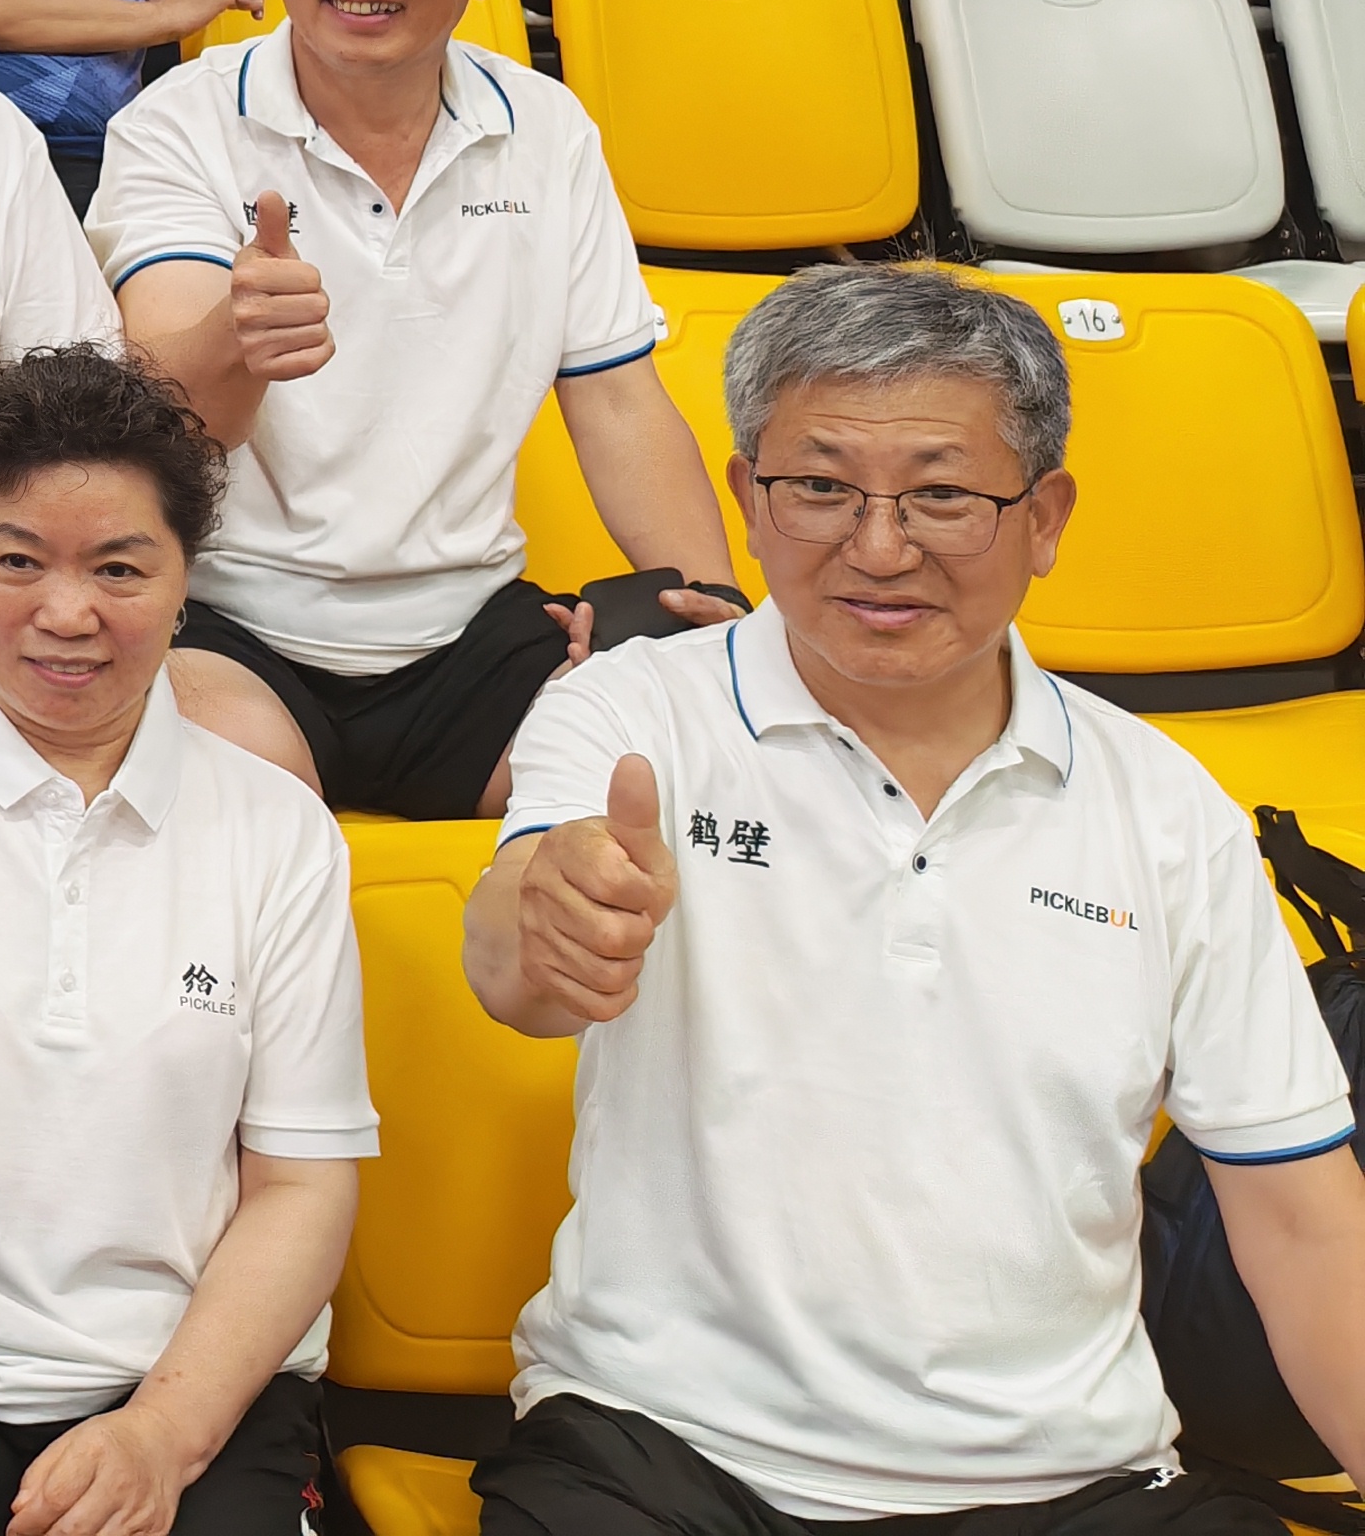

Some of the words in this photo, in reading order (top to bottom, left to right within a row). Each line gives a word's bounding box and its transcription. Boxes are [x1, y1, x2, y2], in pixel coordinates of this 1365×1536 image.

[1079, 308, 1105, 332] 16
[687, 809, 771, 868] 鹤壁
[1030, 886, 1139, 932] PICKLEBUL
